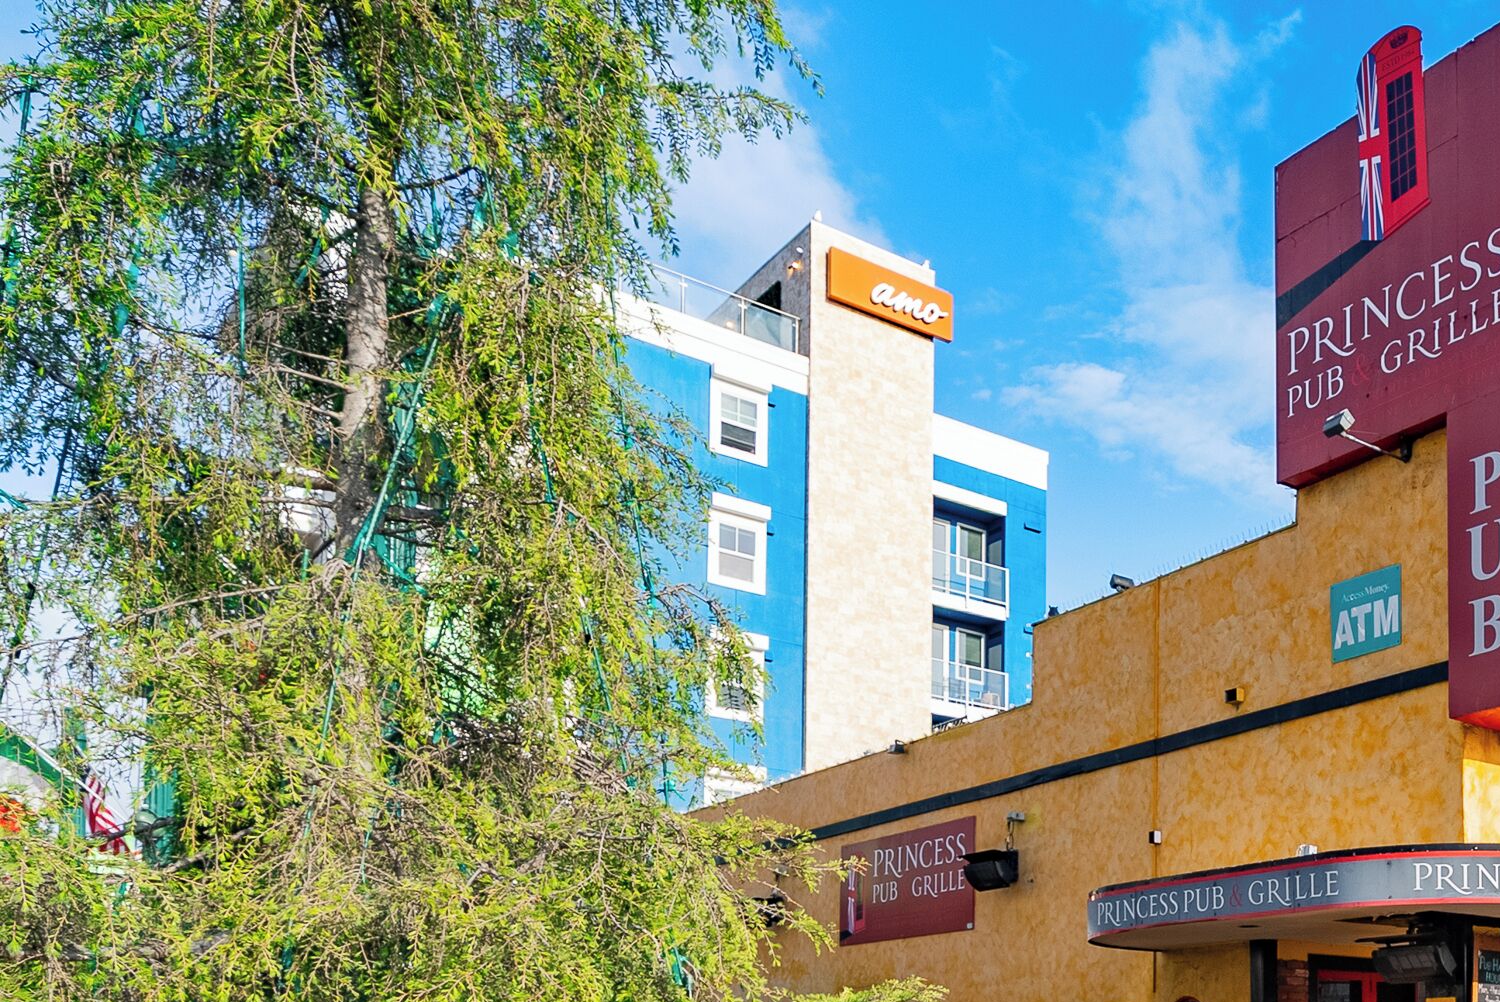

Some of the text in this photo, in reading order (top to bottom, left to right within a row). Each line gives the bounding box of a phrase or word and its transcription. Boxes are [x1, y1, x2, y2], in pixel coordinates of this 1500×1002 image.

[870, 282, 948, 324] amo
[1288, 366, 1343, 417] PUB
[1334, 595, 1398, 650] ATM
[873, 833, 966, 878] PRINCESS
[872, 869, 966, 903] PUB GRILLE
[1097, 892, 1178, 927] PRINCESS
[1183, 885, 1225, 913] PUB
[1249, 870, 1339, 907] GRILLE
